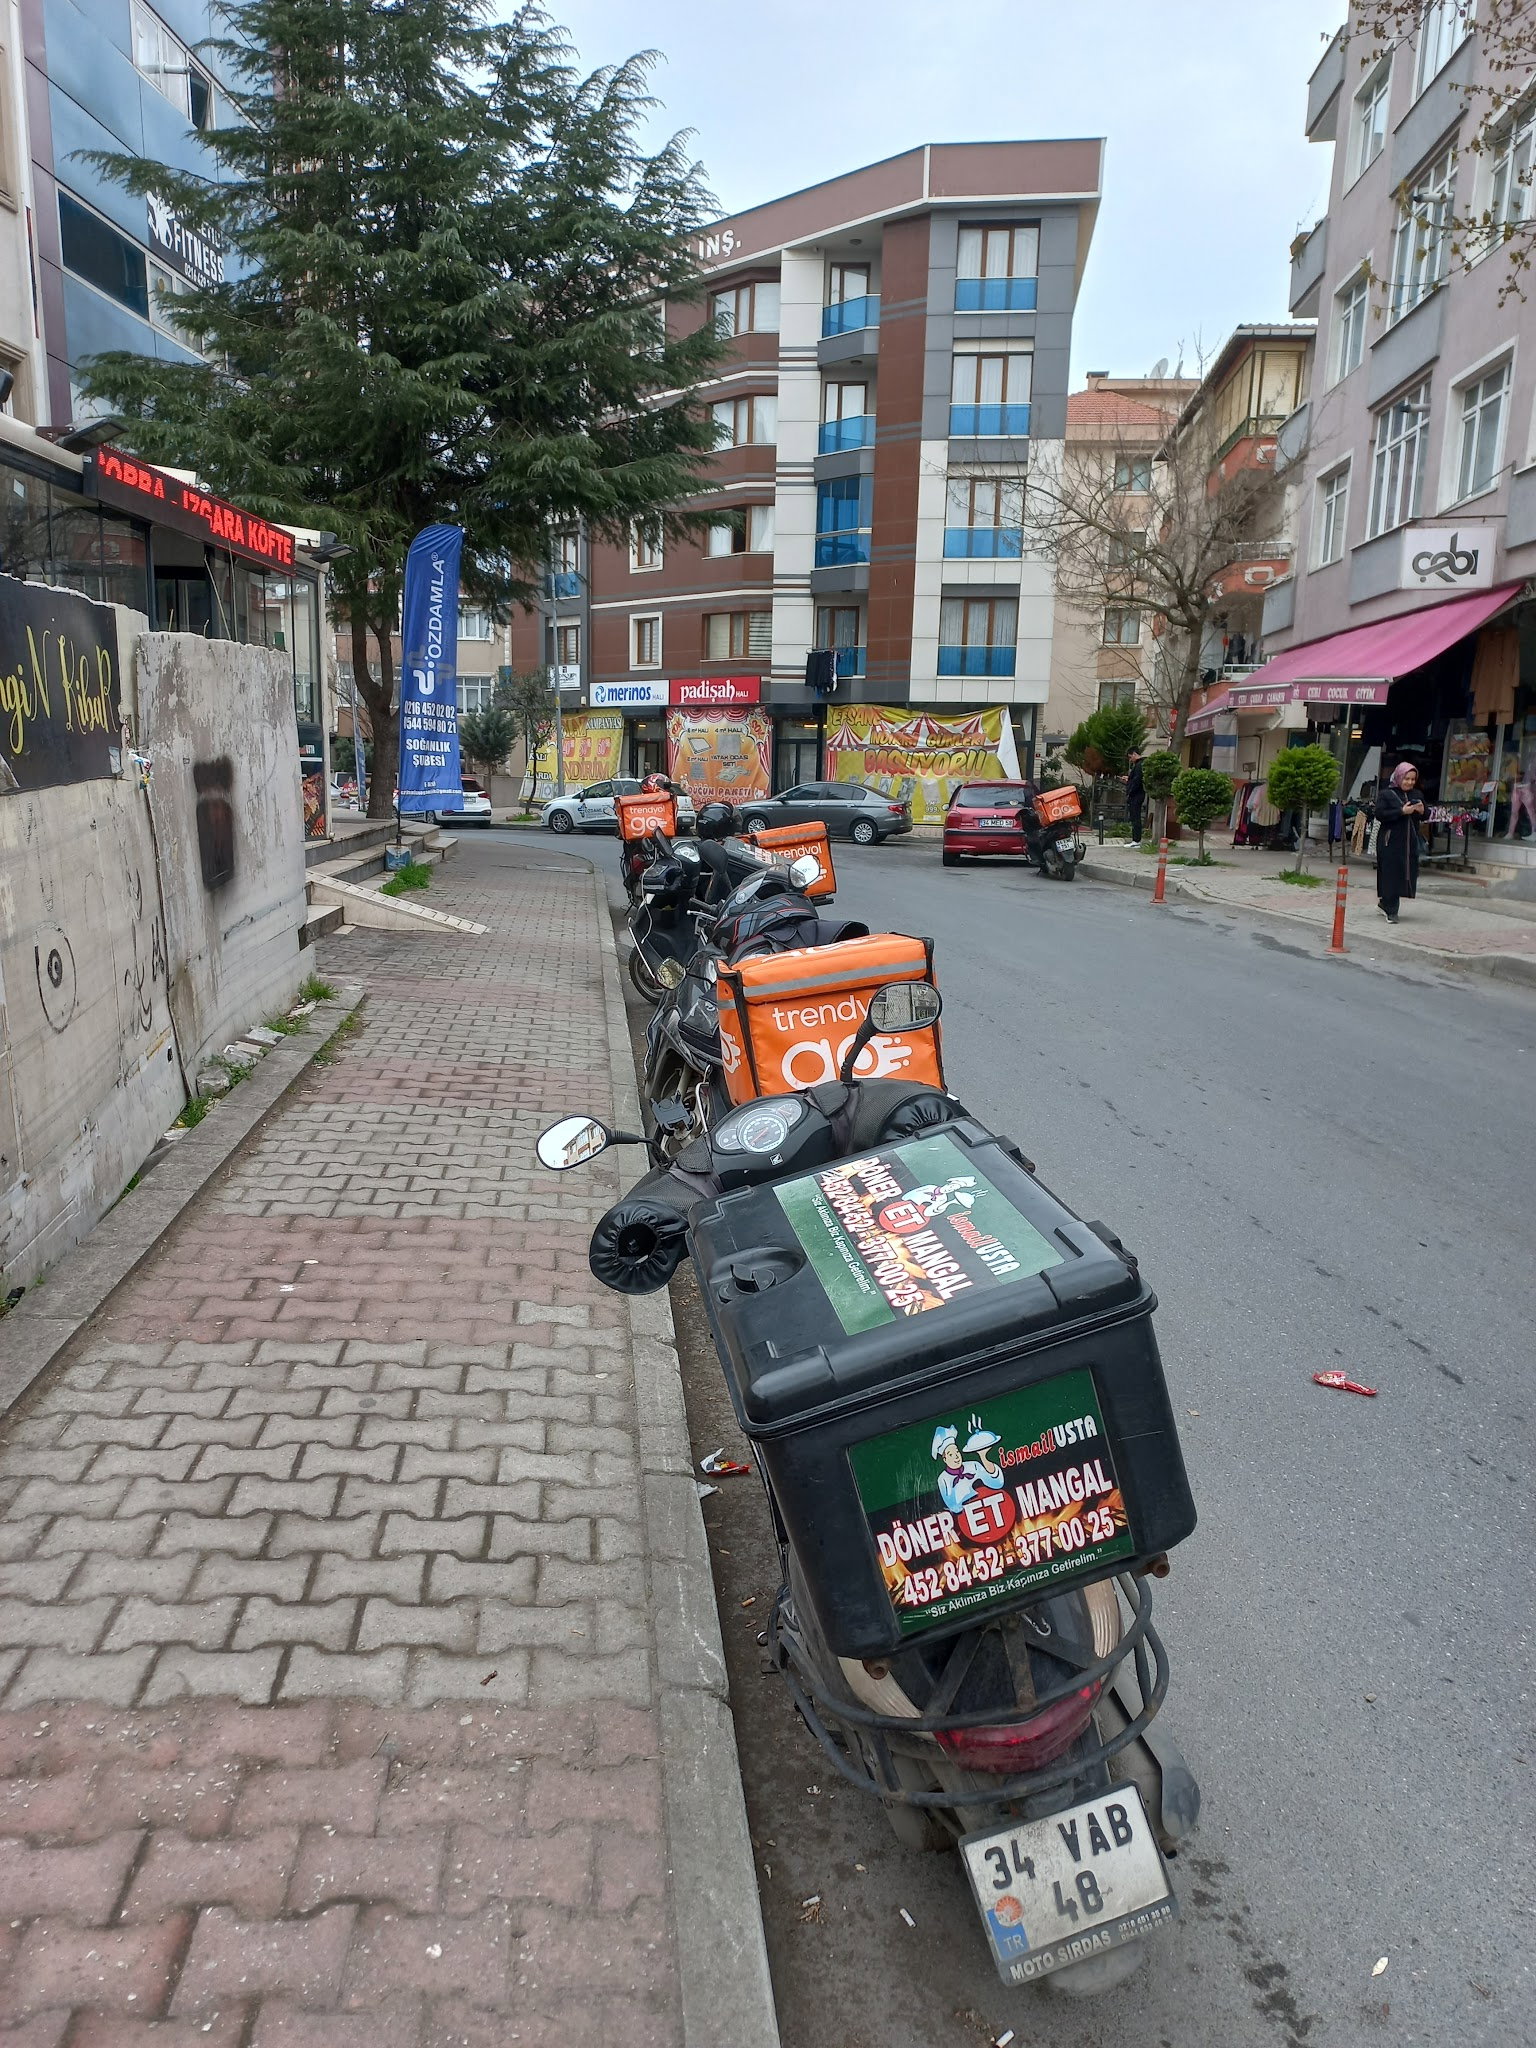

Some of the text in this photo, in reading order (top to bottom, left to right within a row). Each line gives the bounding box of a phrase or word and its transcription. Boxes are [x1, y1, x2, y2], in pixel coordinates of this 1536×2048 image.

[173, 219, 225, 284] FITNESS
[248, 520, 293, 566] KÖFTE
[607, 686, 652, 702] merinos
[680, 679, 749, 704] padişah HALI
[404, 700, 456, 719] 0216 452 02 02
[447, 721, 457, 734] 21
[406, 738, 452, 753] SOĞANLIK
[412, 754, 446, 768] ŞUBESİ
[560, 757, 610, 781] NDİRİM
[629, 804, 666, 815] trendyol
[630, 815, 668, 837] go
[772, 994, 873, 1032] trendy
[821, 1171, 856, 1200] 452
[827, 1225, 840, 1238] Biz
[842, 1209, 876, 1233] 52
[852, 1156, 975, 1300] DÖNER ET MANGAL
[857, 1234, 899, 1264] 377
[873, 1262, 911, 1287] 00
[883, 1282, 925, 1308] 25
[876, 1458, 1114, 1569] DÖNER ET MANGAL
[901, 1569, 944, 1608] 452
[942, 1557, 974, 1593] 84
[973, 1546, 1006, 1585] 52
[1014, 1525, 1058, 1569] 377
[1056, 1516, 1088, 1553] 00
[1087, 1505, 1117, 1545] 25
[947, 1587, 989, 1614] Aklınıza
[988, 1581, 1006, 1597] Biz
[1005, 1569, 1051, 1593] Kapınıza
[983, 1802, 1134, 1891] 34 VAB
[1052, 1869, 1105, 1924] 48
[1002, 1934, 1025, 1953] TR
[1008, 1928, 1112, 1982] MOTO SIRDAS
